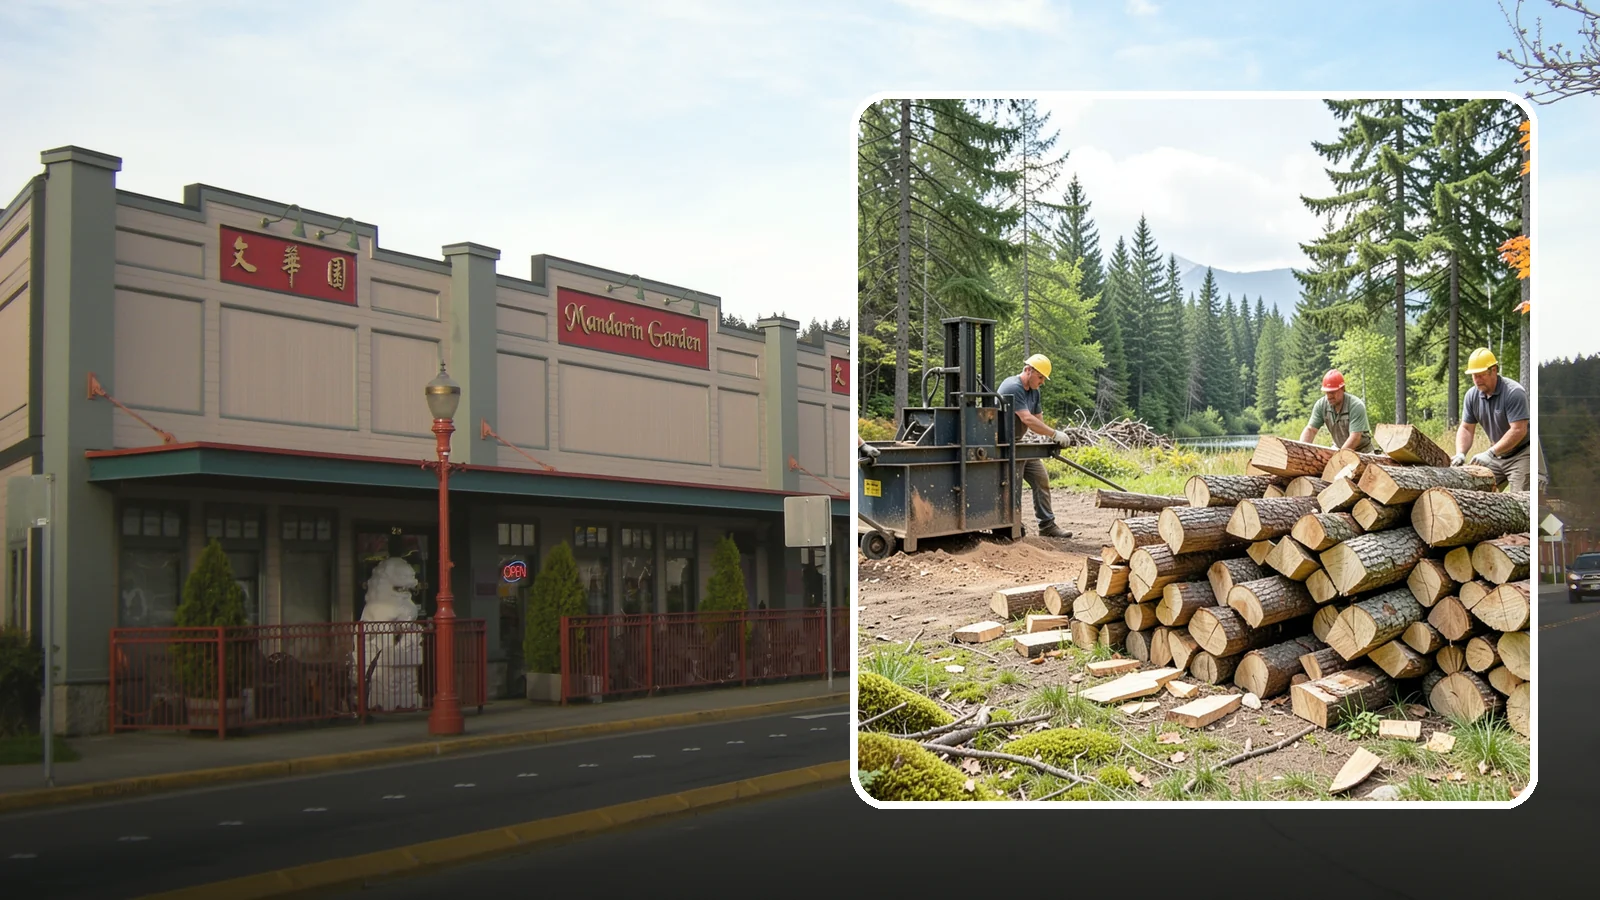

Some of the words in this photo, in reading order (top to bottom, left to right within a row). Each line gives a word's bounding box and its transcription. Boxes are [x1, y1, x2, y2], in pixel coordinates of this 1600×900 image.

[230, 235, 346, 291] 文華園
[564, 302, 644, 341] Mandarin
[648, 320, 701, 352] Garden
[503, 565, 527, 578] OPEN
